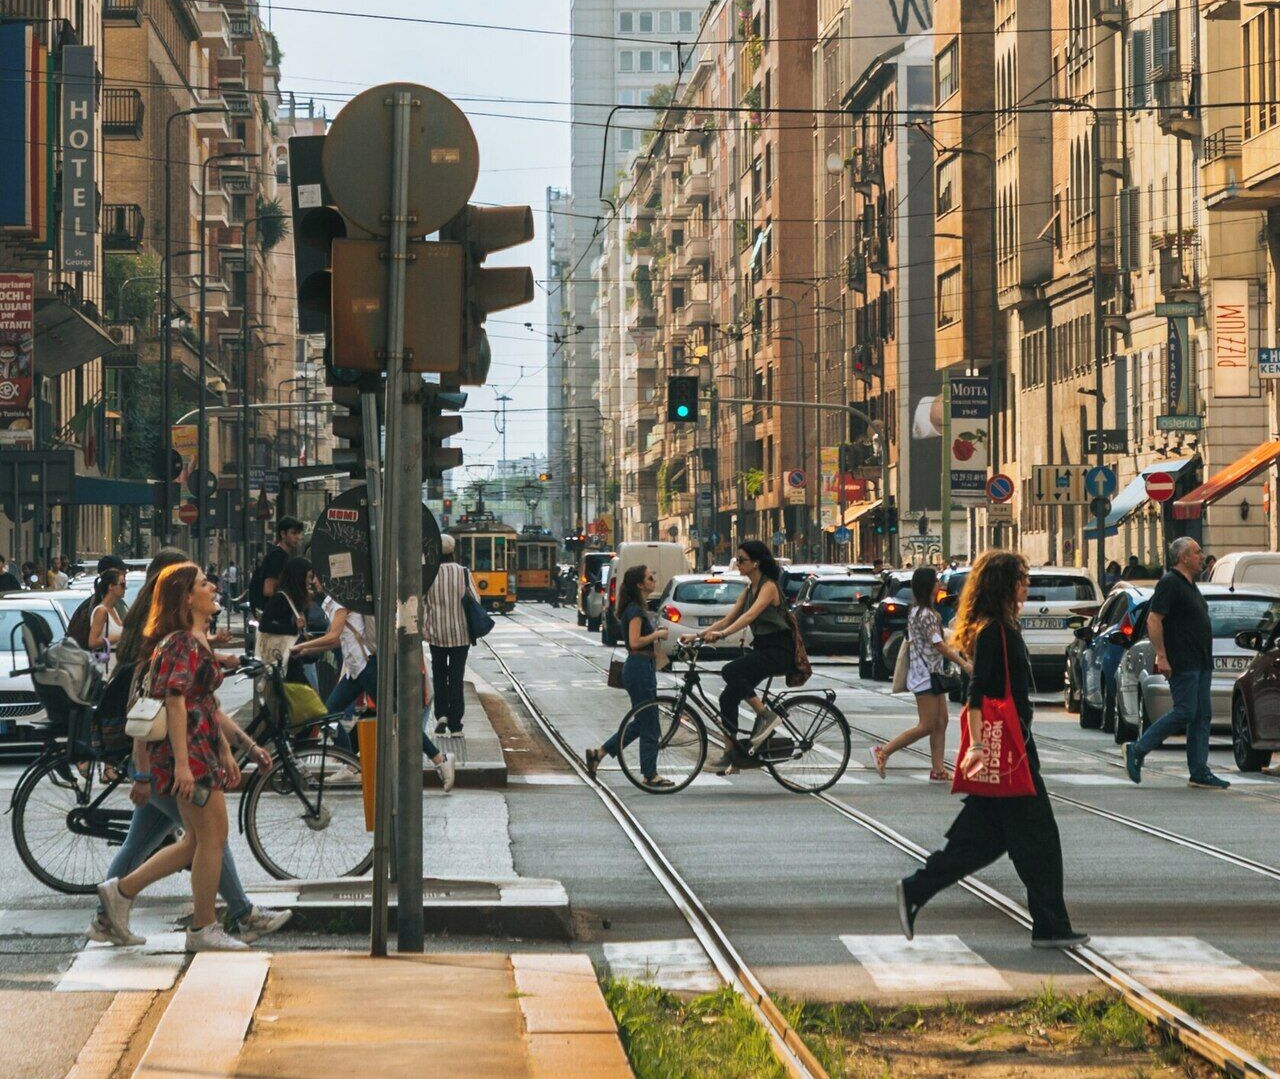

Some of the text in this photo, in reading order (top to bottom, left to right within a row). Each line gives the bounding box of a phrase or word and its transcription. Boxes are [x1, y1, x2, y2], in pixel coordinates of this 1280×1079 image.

[69, 101, 89, 236] HOTEL
[1216, 304, 1247, 368] PIZZIUM
[952, 384, 988, 396] MOTTA
[1162, 418, 1198, 428] osteria
[1215, 658, 1249, 668] CN 467
[989, 720, 1004, 784] DI DESIGN
